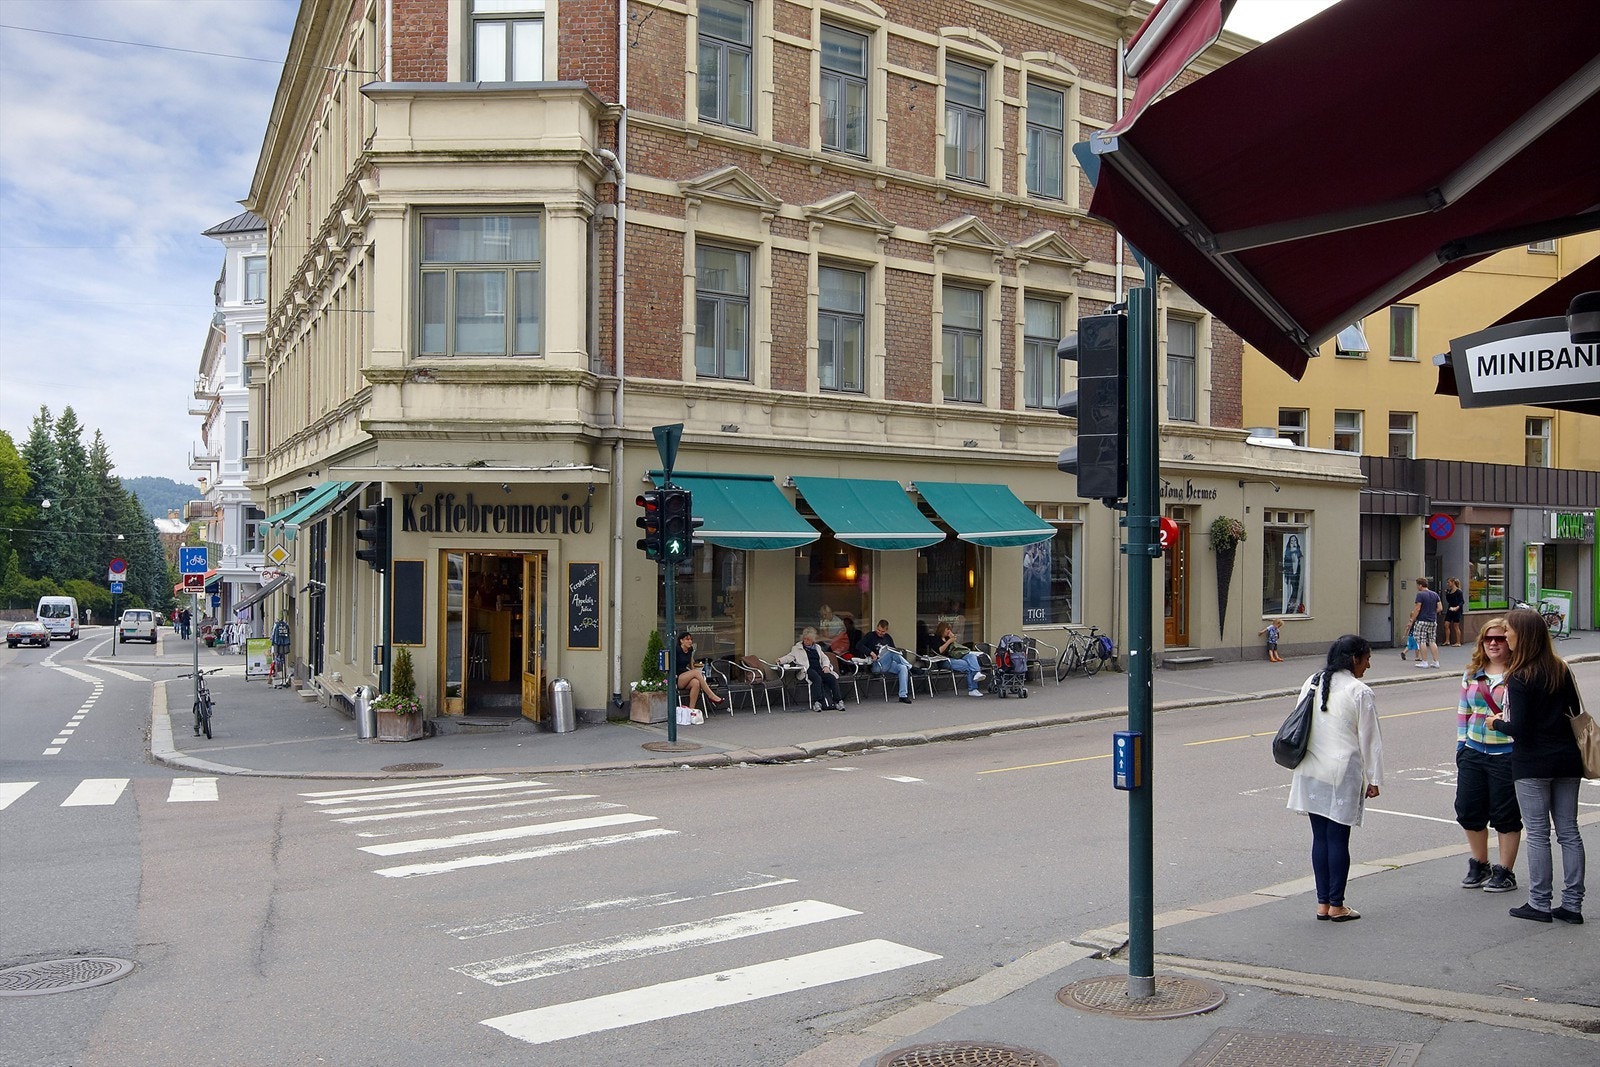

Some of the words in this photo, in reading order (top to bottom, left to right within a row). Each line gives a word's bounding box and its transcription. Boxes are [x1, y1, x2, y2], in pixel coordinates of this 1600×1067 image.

[1477, 344, 1600, 377] MINIBAN
[1160, 483, 1183, 500] along
[401, 493, 593, 534] Kaffebrenneriet
[1557, 513, 1585, 538] KIWI
[1027, 608, 1045, 619] TIGI
